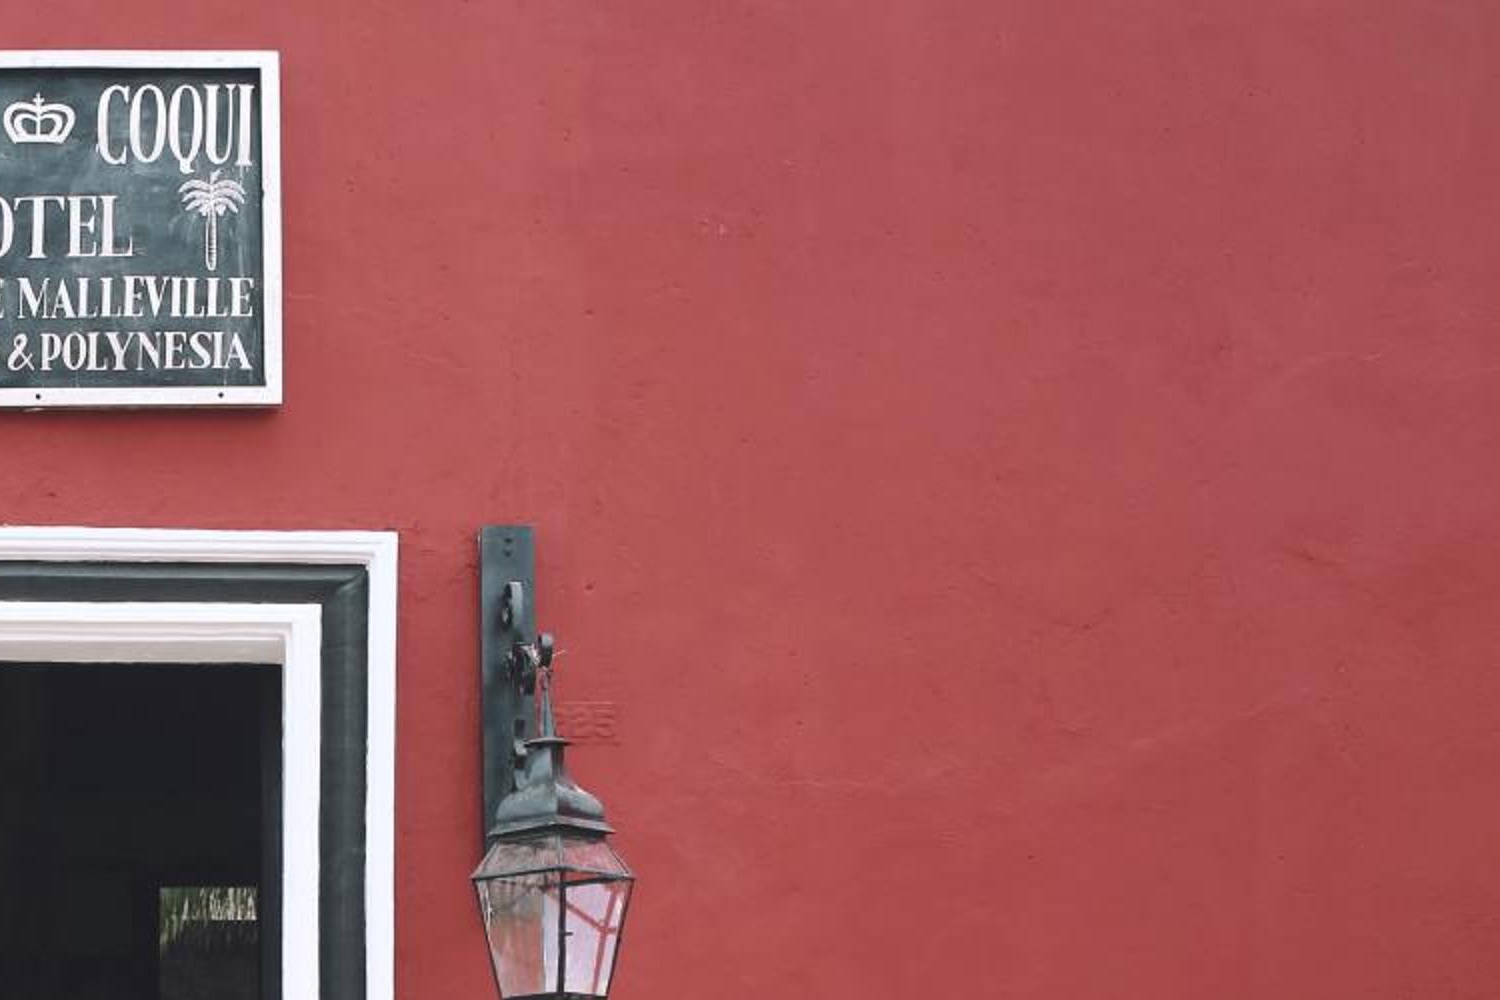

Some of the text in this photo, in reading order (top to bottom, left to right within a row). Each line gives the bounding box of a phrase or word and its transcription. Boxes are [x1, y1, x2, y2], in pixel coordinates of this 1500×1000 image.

[97, 83, 255, 174] COQUI
[18, 276, 254, 318] MALLEVILLE
[8, 333, 34, 372] &
[40, 331, 253, 372] POLYNESIA
